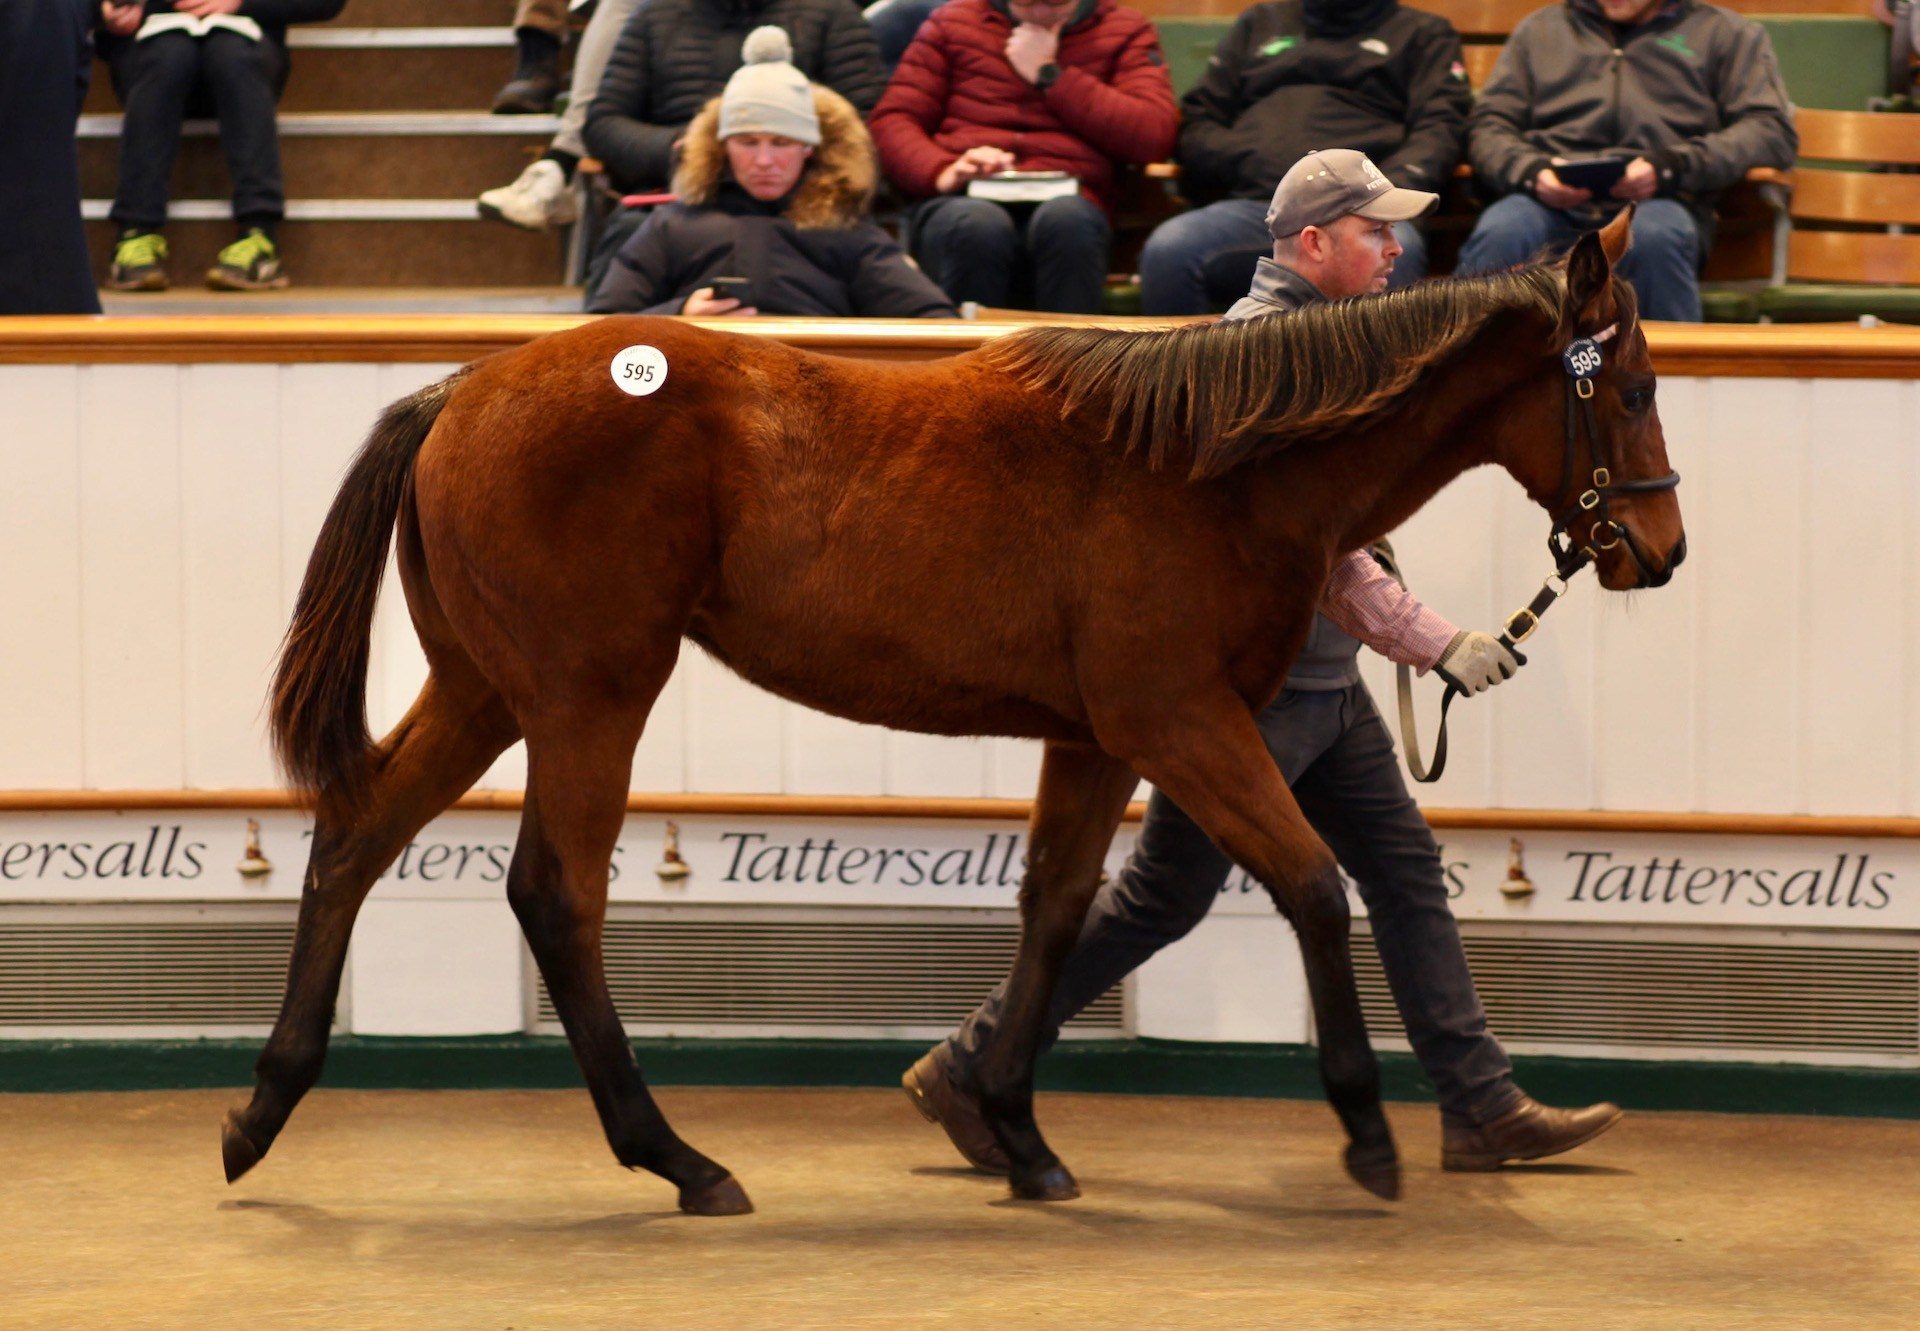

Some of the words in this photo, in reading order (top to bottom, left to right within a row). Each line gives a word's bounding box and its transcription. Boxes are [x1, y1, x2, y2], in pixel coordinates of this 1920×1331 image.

[623, 363, 655, 382] 595
[1570, 346, 1602, 375] 595
[0, 825, 207, 879] ersalls
[1565, 850, 1895, 910] Tattersalls
